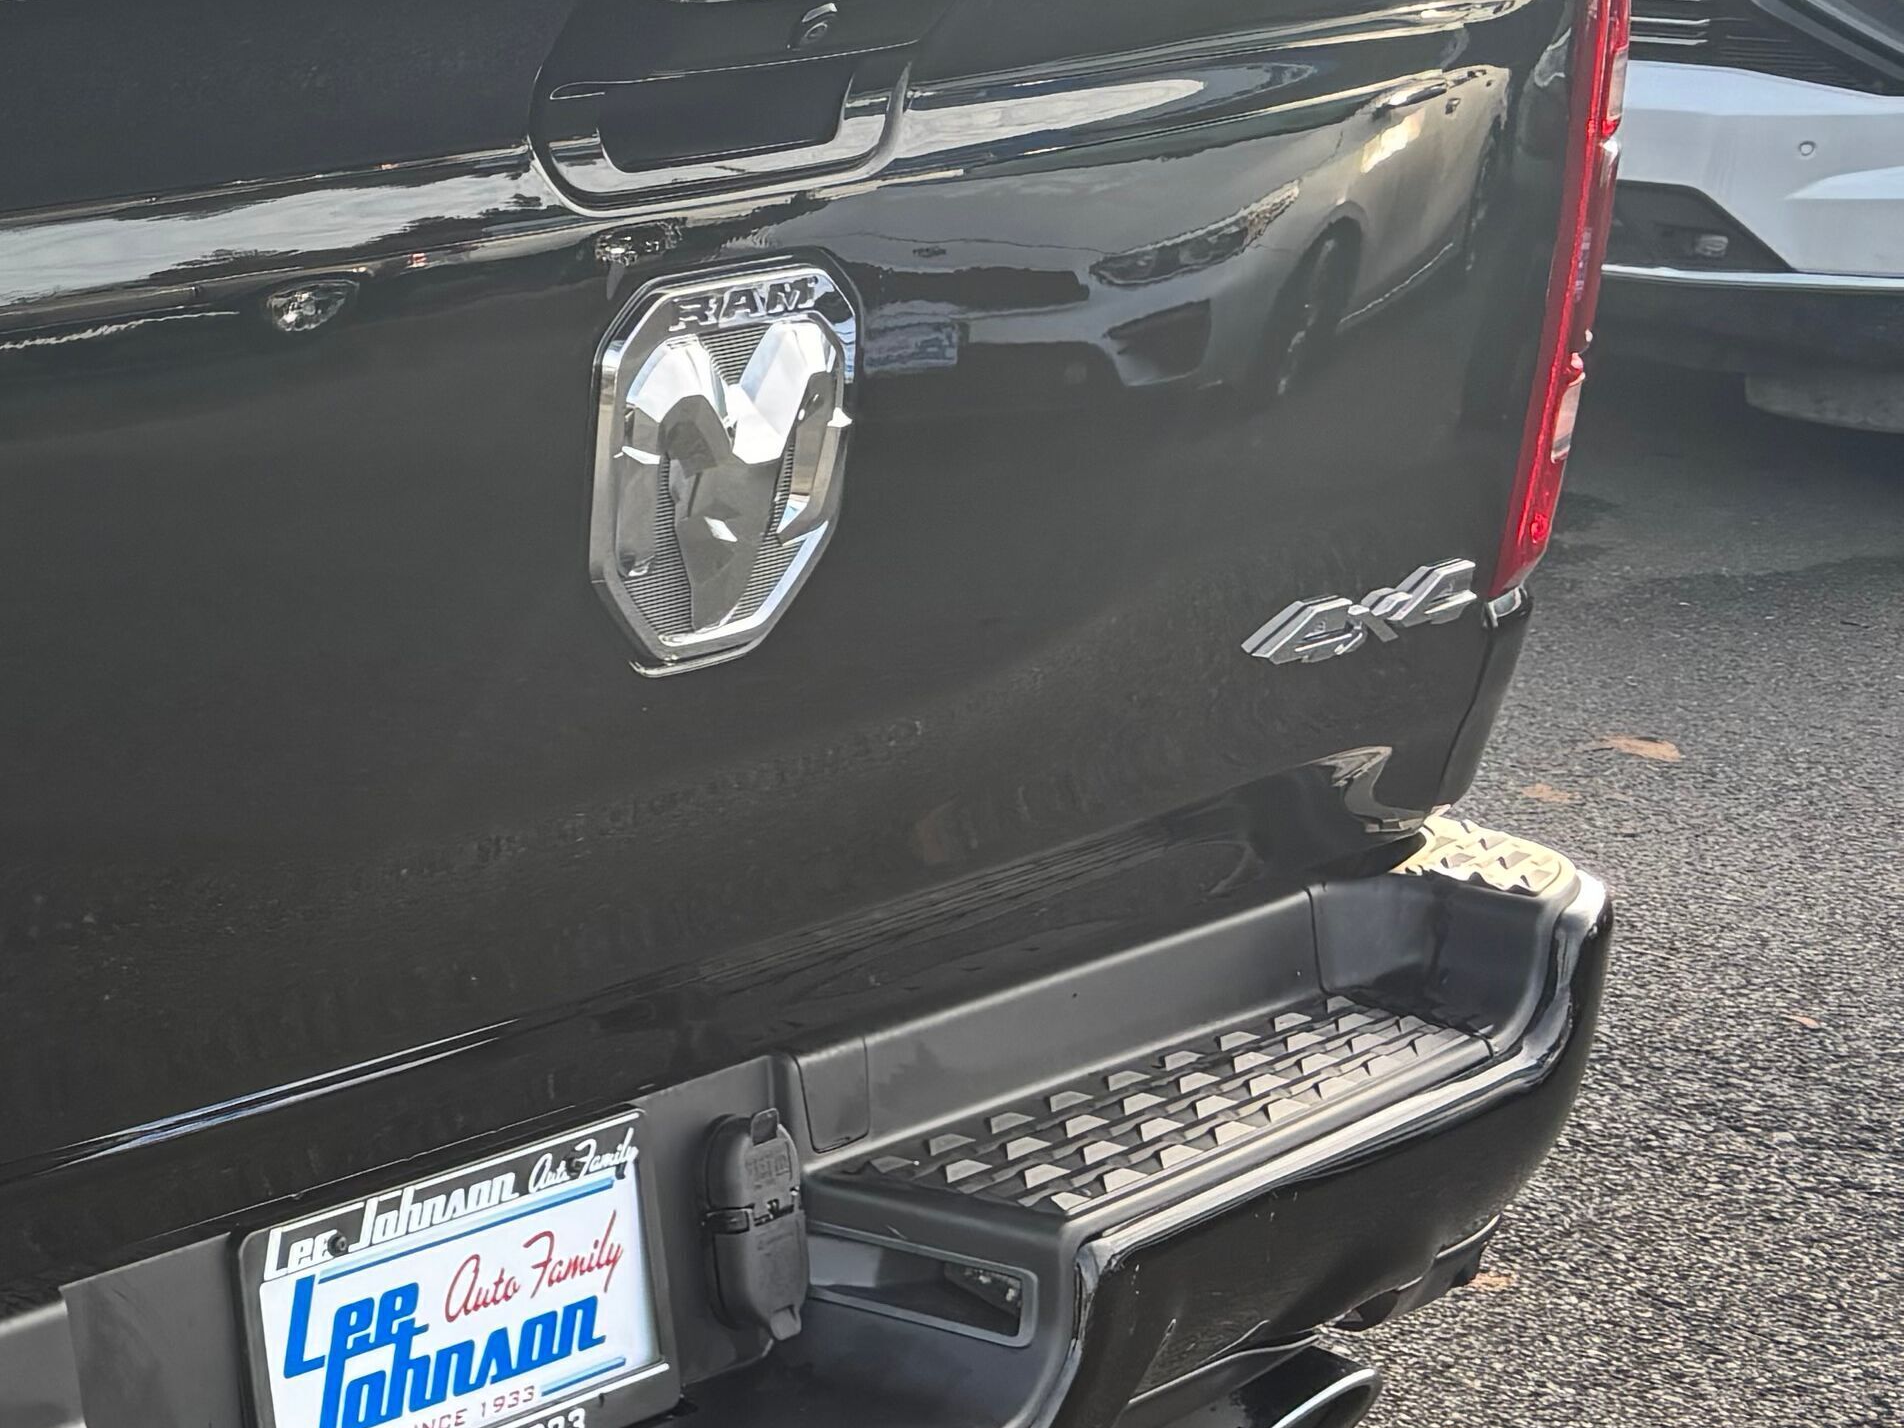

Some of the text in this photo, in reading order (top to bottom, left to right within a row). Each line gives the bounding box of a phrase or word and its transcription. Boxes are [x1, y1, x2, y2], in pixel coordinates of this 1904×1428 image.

[668, 276, 819, 332] RAM
[348, 1172, 520, 1254] Johnson
[572, 1127, 639, 1177] Family
[445, 1210, 623, 1324] Auto Family
[284, 1275, 420, 1379] Lee
[480, 1385, 535, 1418] 1933
